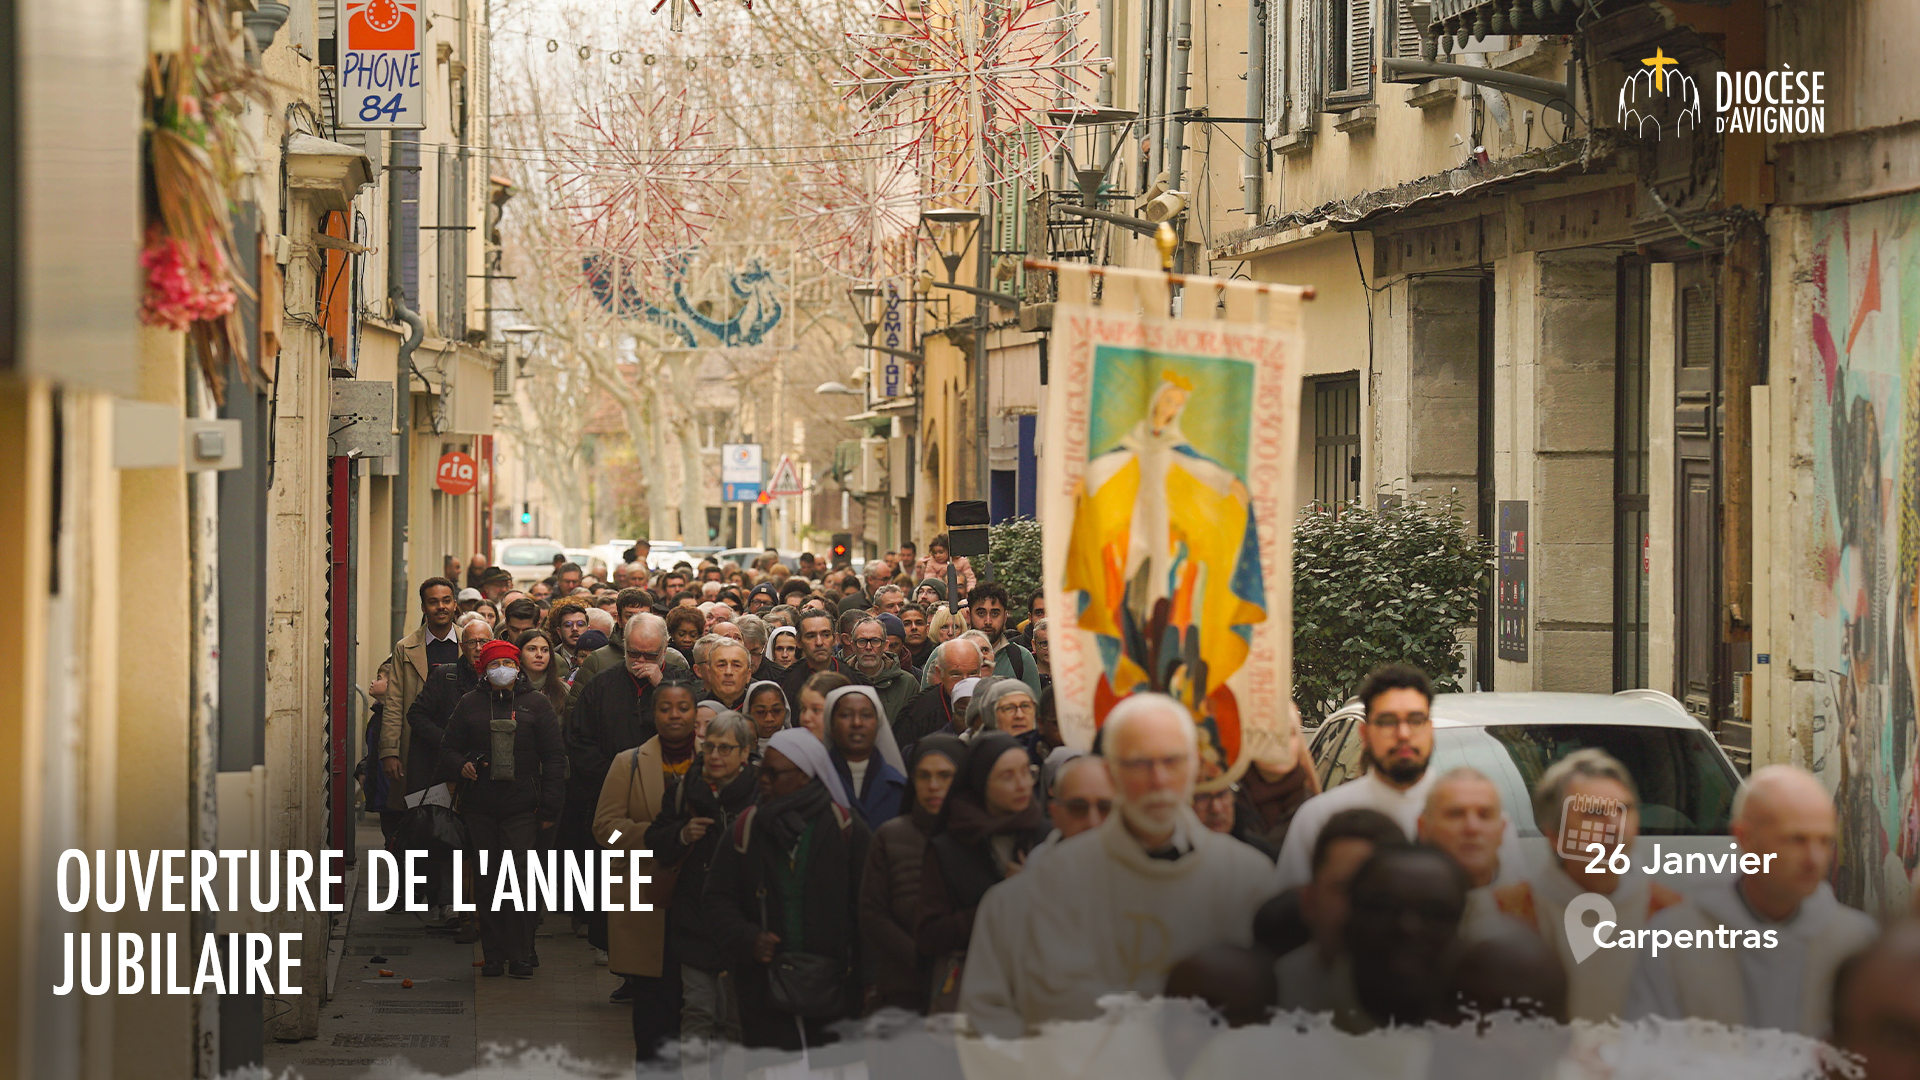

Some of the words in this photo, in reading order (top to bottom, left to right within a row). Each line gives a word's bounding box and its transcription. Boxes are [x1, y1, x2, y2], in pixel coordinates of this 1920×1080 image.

[343, 52, 420, 91] PHONE
[359, 93, 407, 123] 84
[440, 456, 473, 480] ria
